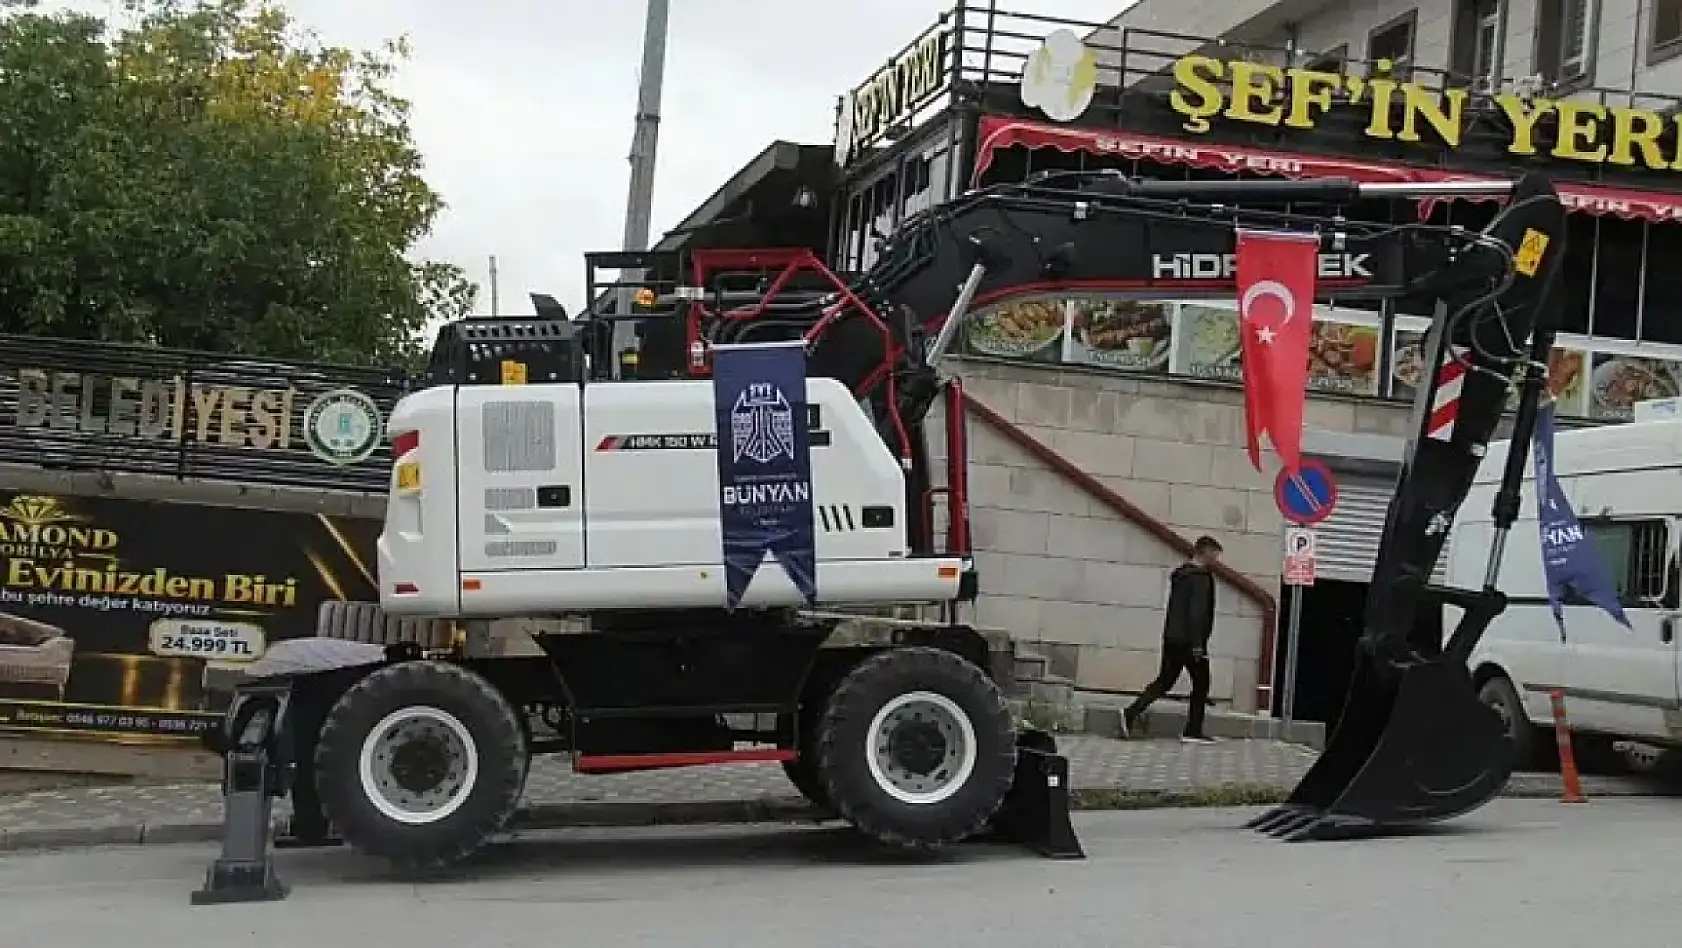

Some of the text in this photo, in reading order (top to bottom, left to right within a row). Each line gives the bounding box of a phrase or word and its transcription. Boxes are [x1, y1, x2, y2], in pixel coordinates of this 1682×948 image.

[8, 557, 298, 606] Evinizden Biri
[161, 635, 253, 655] 24.999 TL
